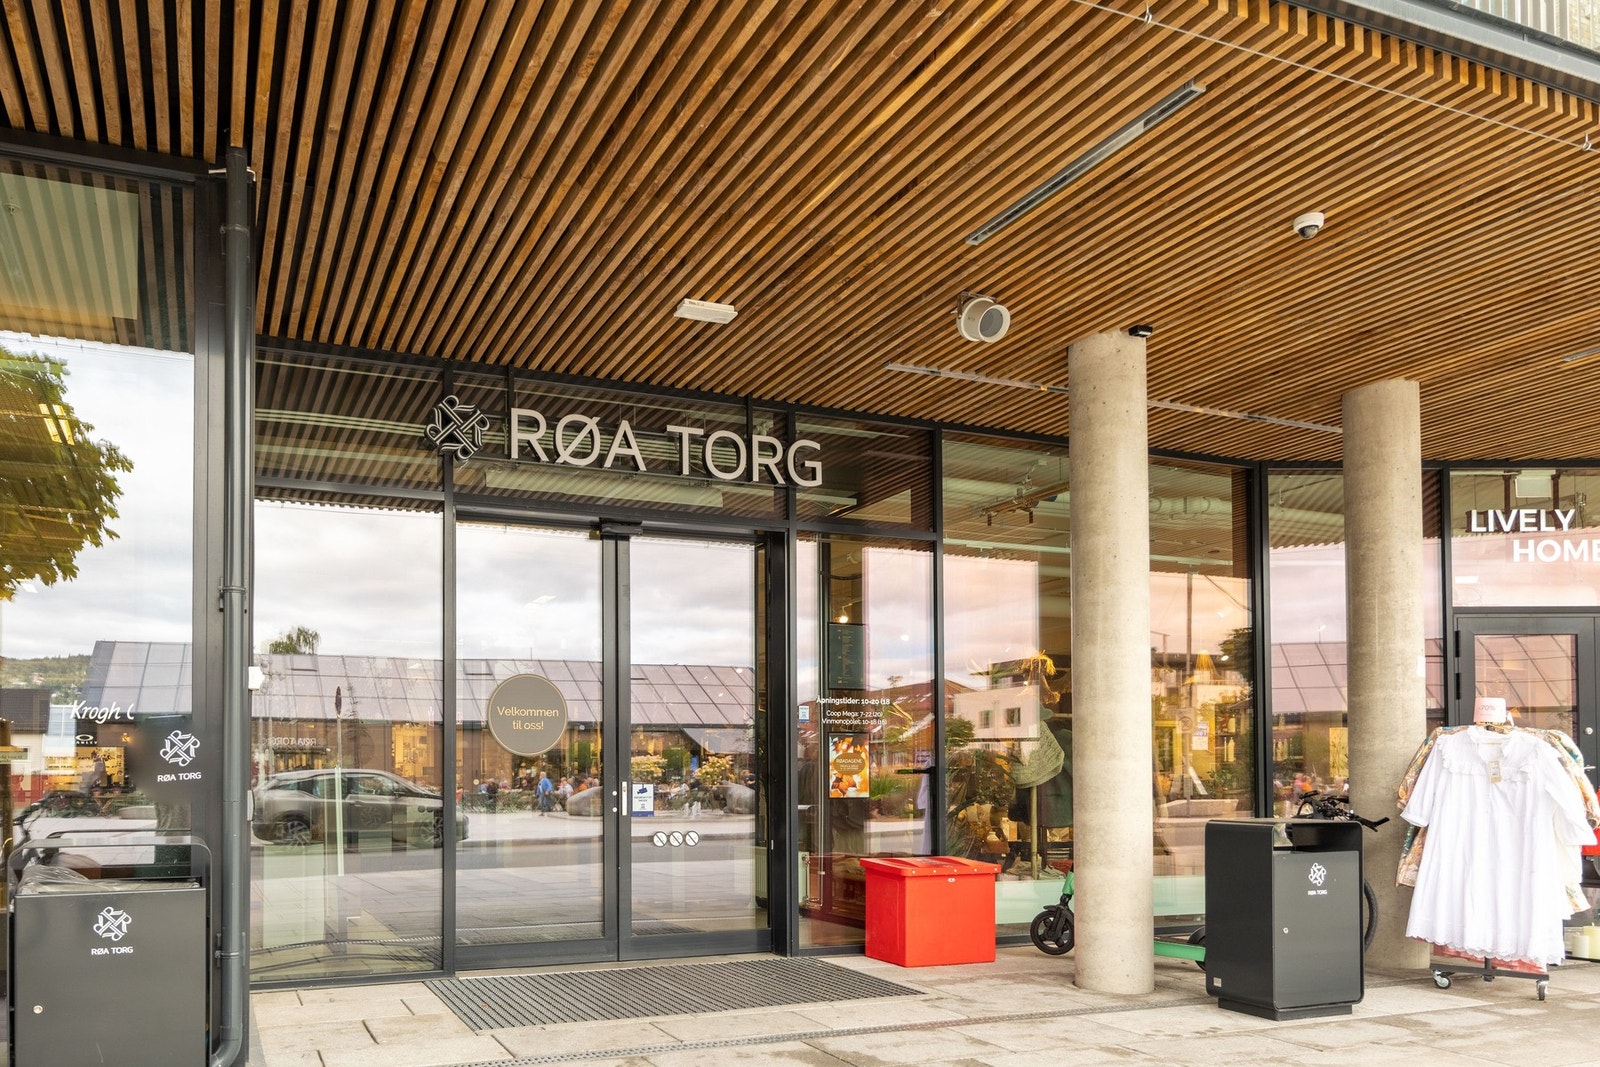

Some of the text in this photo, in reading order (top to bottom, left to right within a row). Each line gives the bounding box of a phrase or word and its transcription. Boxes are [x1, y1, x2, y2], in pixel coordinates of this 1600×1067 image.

[510, 407, 823, 487] RØA TORG
[1471, 509, 1575, 532] LIVELY
[70, 700, 121, 724] Krogh
[497, 706, 559, 717] Velkommen
[512, 720, 544, 730] til oss!
[157, 772, 202, 782] RØA TORG
[91, 946, 134, 956] RØA TORG
